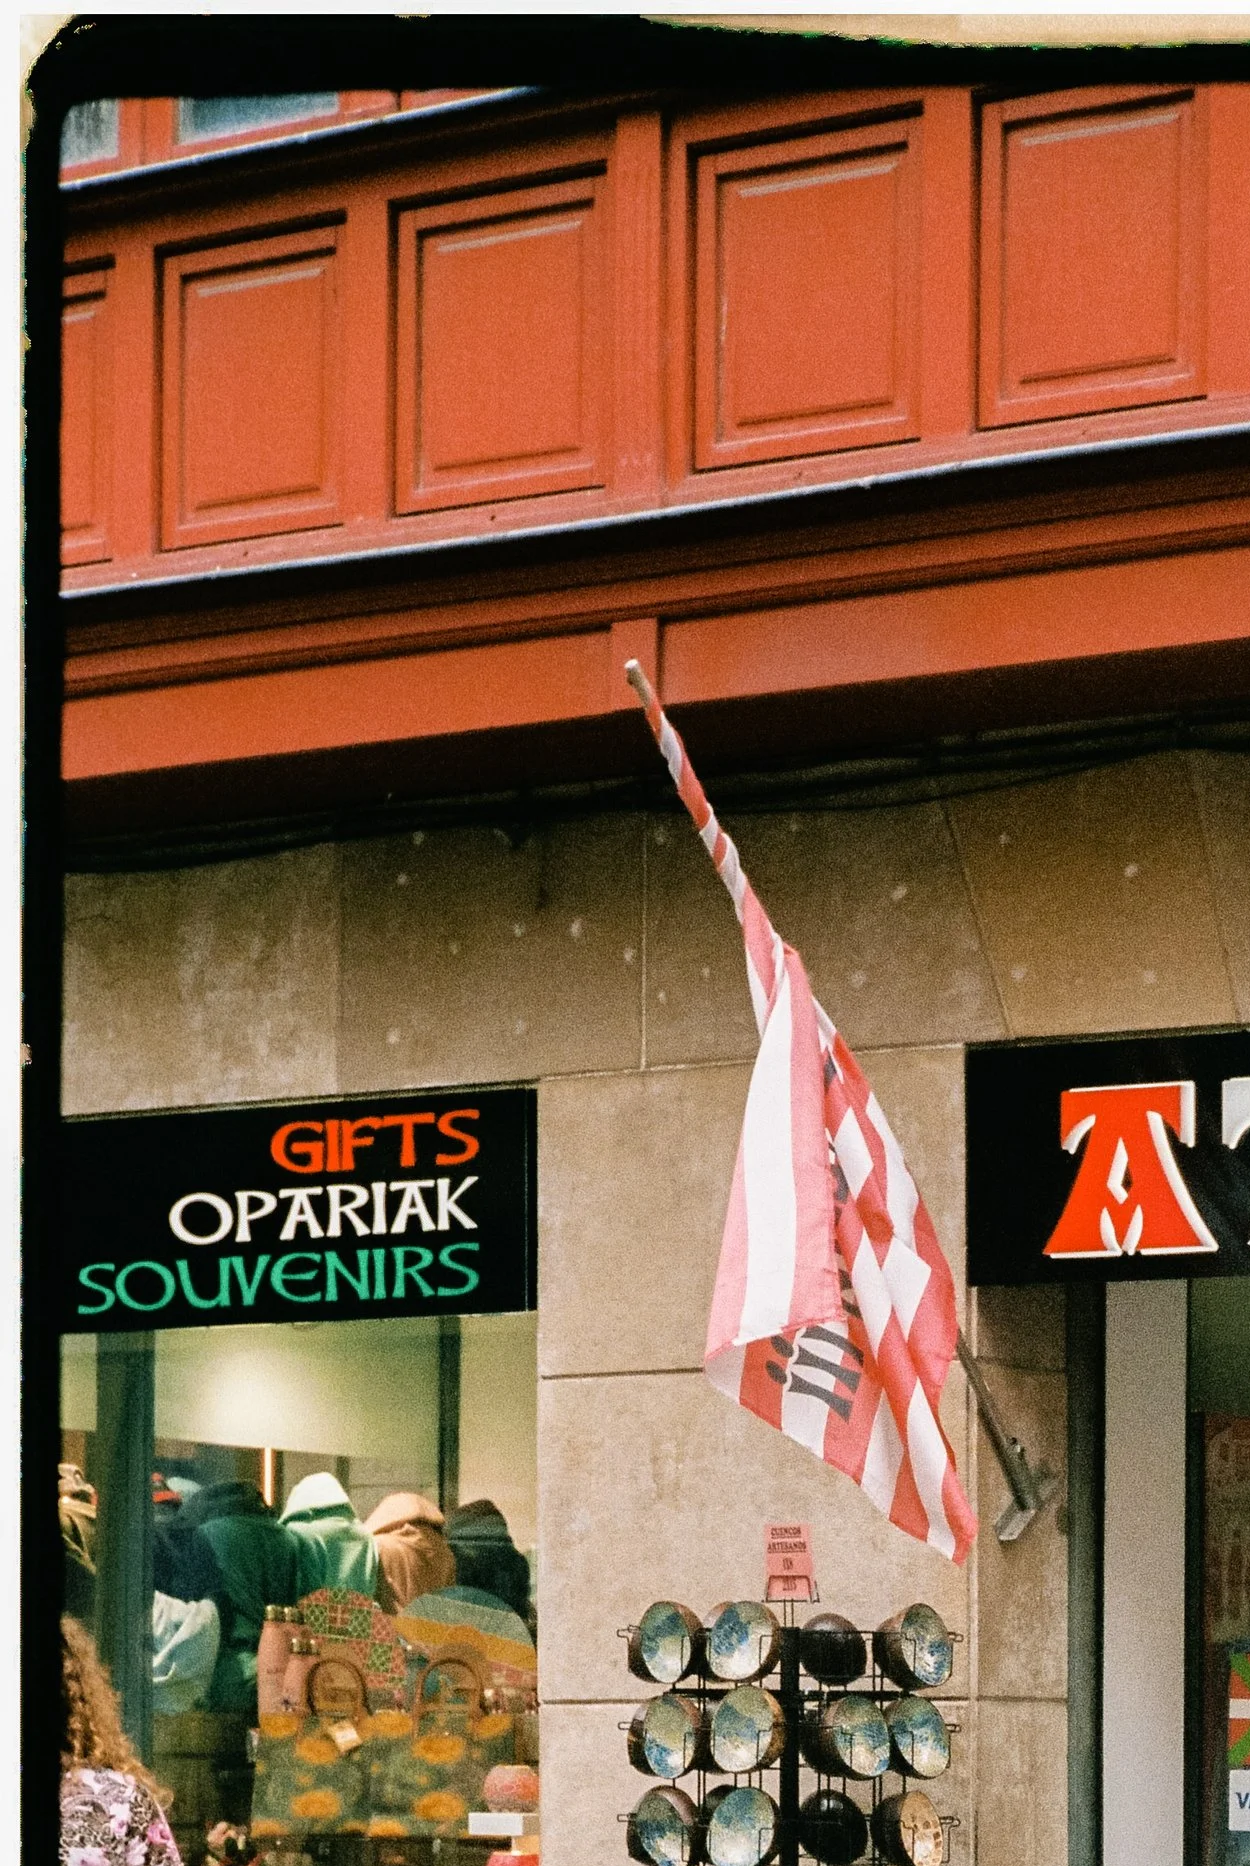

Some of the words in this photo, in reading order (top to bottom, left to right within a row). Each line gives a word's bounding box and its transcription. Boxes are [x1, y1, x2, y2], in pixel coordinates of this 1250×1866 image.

[270, 1109, 480, 1174] GIFTS
[168, 1176, 479, 1245] OPARIAK
[77, 1242, 480, 1315] SOUVENIRS
